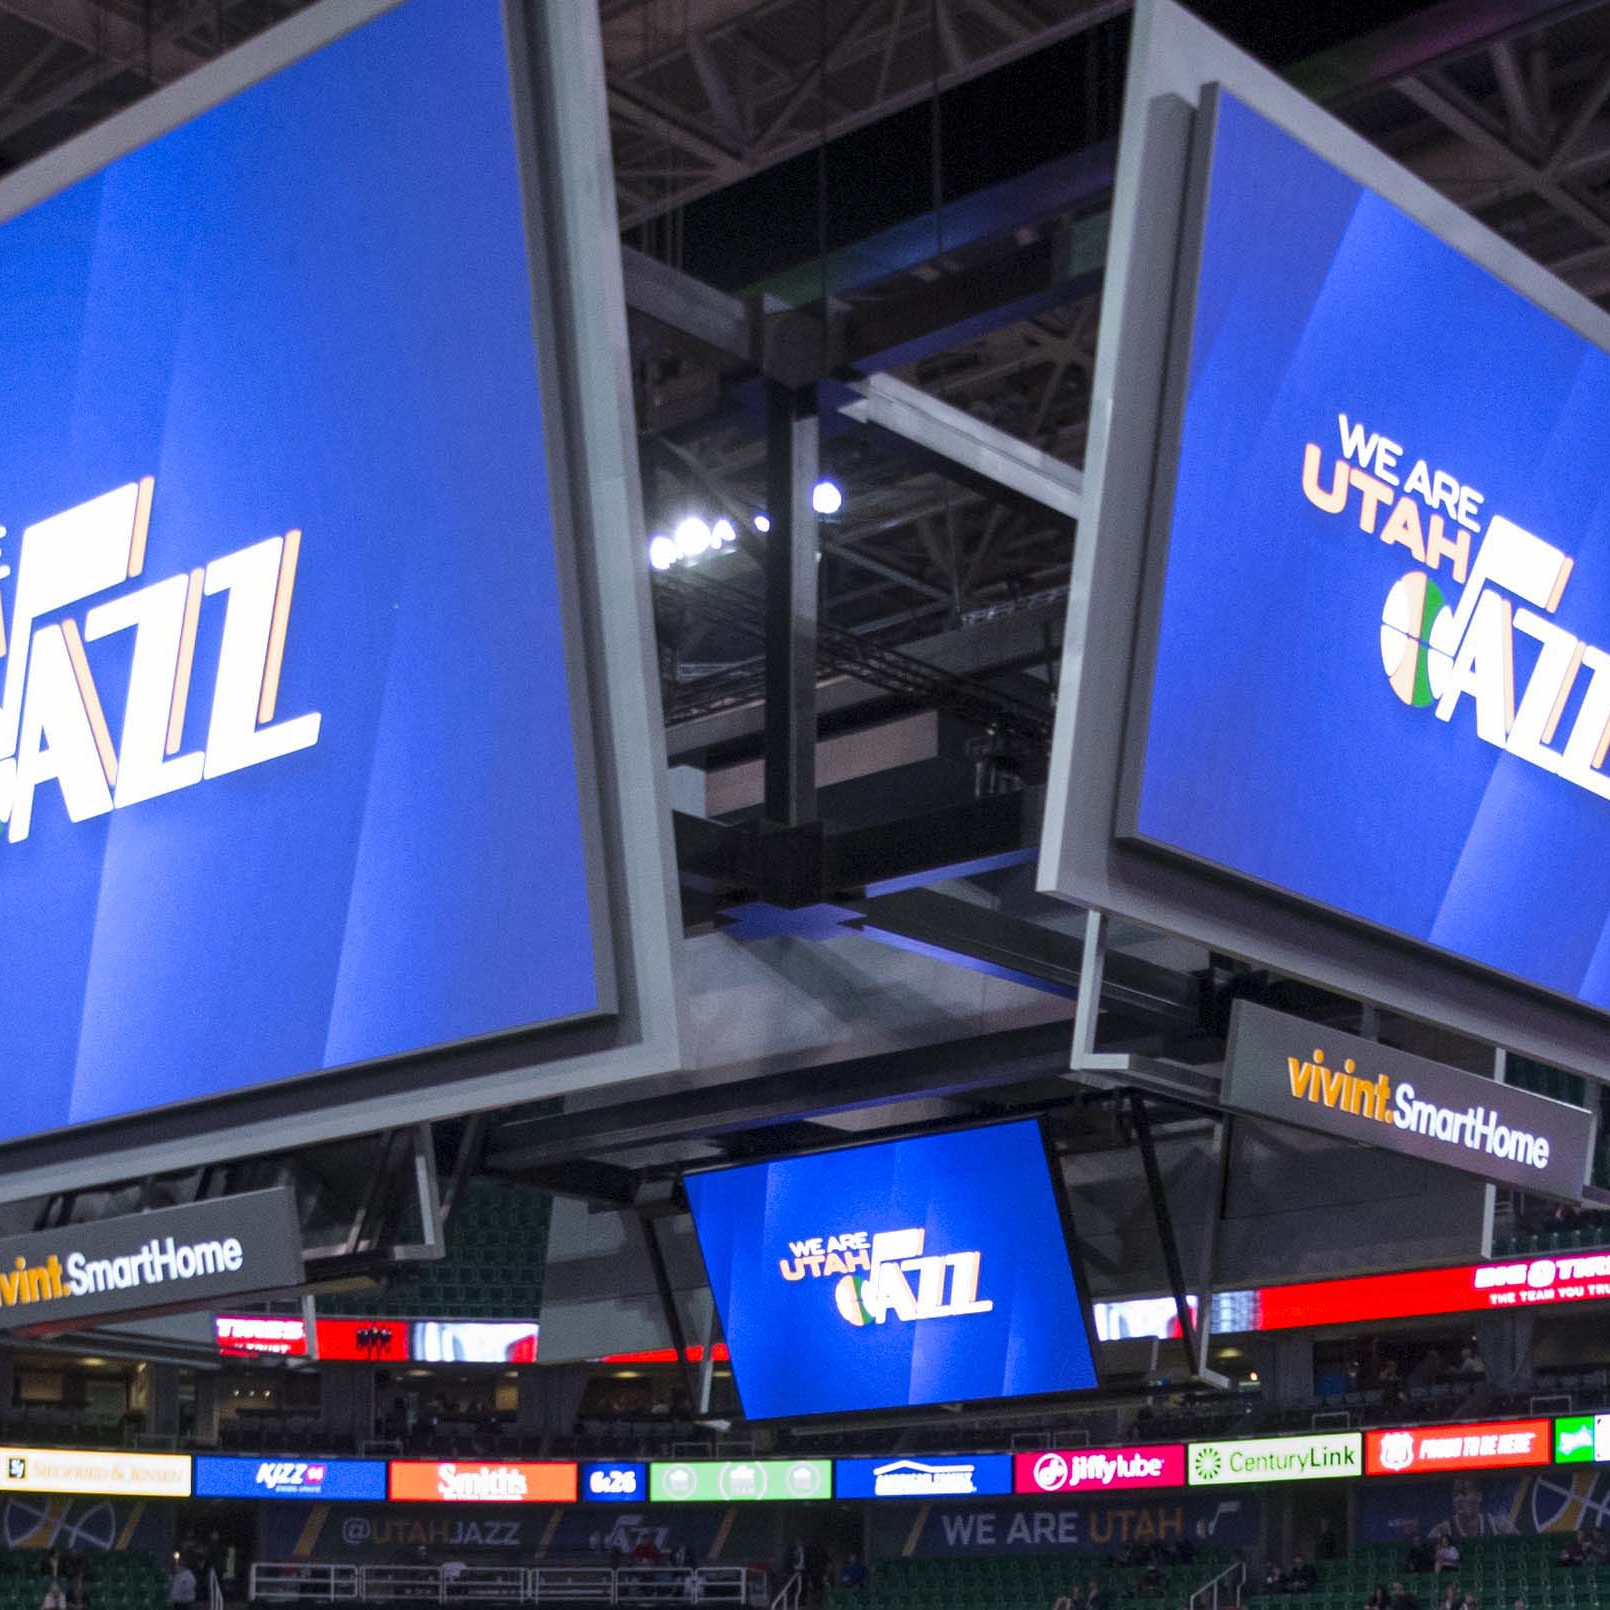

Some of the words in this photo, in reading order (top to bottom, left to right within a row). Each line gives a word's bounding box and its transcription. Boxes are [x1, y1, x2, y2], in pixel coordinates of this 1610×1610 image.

[1338, 413, 1404, 487] WE
[1404, 459, 1485, 533] ARE
[1301, 442, 1472, 585] UTAH
[789, 1238, 825, 1258] WE
[826, 1231, 871, 1252] ARE
[779, 1249, 871, 1282] UTAH
[834, 1228, 993, 1327] JAZZ
[1474, 1263, 1528, 1288] BIG
[1489, 1293, 1517, 1306] THE
[1519, 1288, 1555, 1303] TEAM
[1557, 1285, 1585, 1299] YOU
[1228, 1444, 1356, 1474] CenturyLink
[255, 1462, 308, 1490] KJZZ
[589, 1470, 637, 1494] 6:26
[341, 1516, 521, 1546] @UTAHJAZZ
[942, 1512, 997, 1547] WE
[1005, 1510, 1080, 1545] ARE
[1087, 1506, 1183, 1544] UTAH
